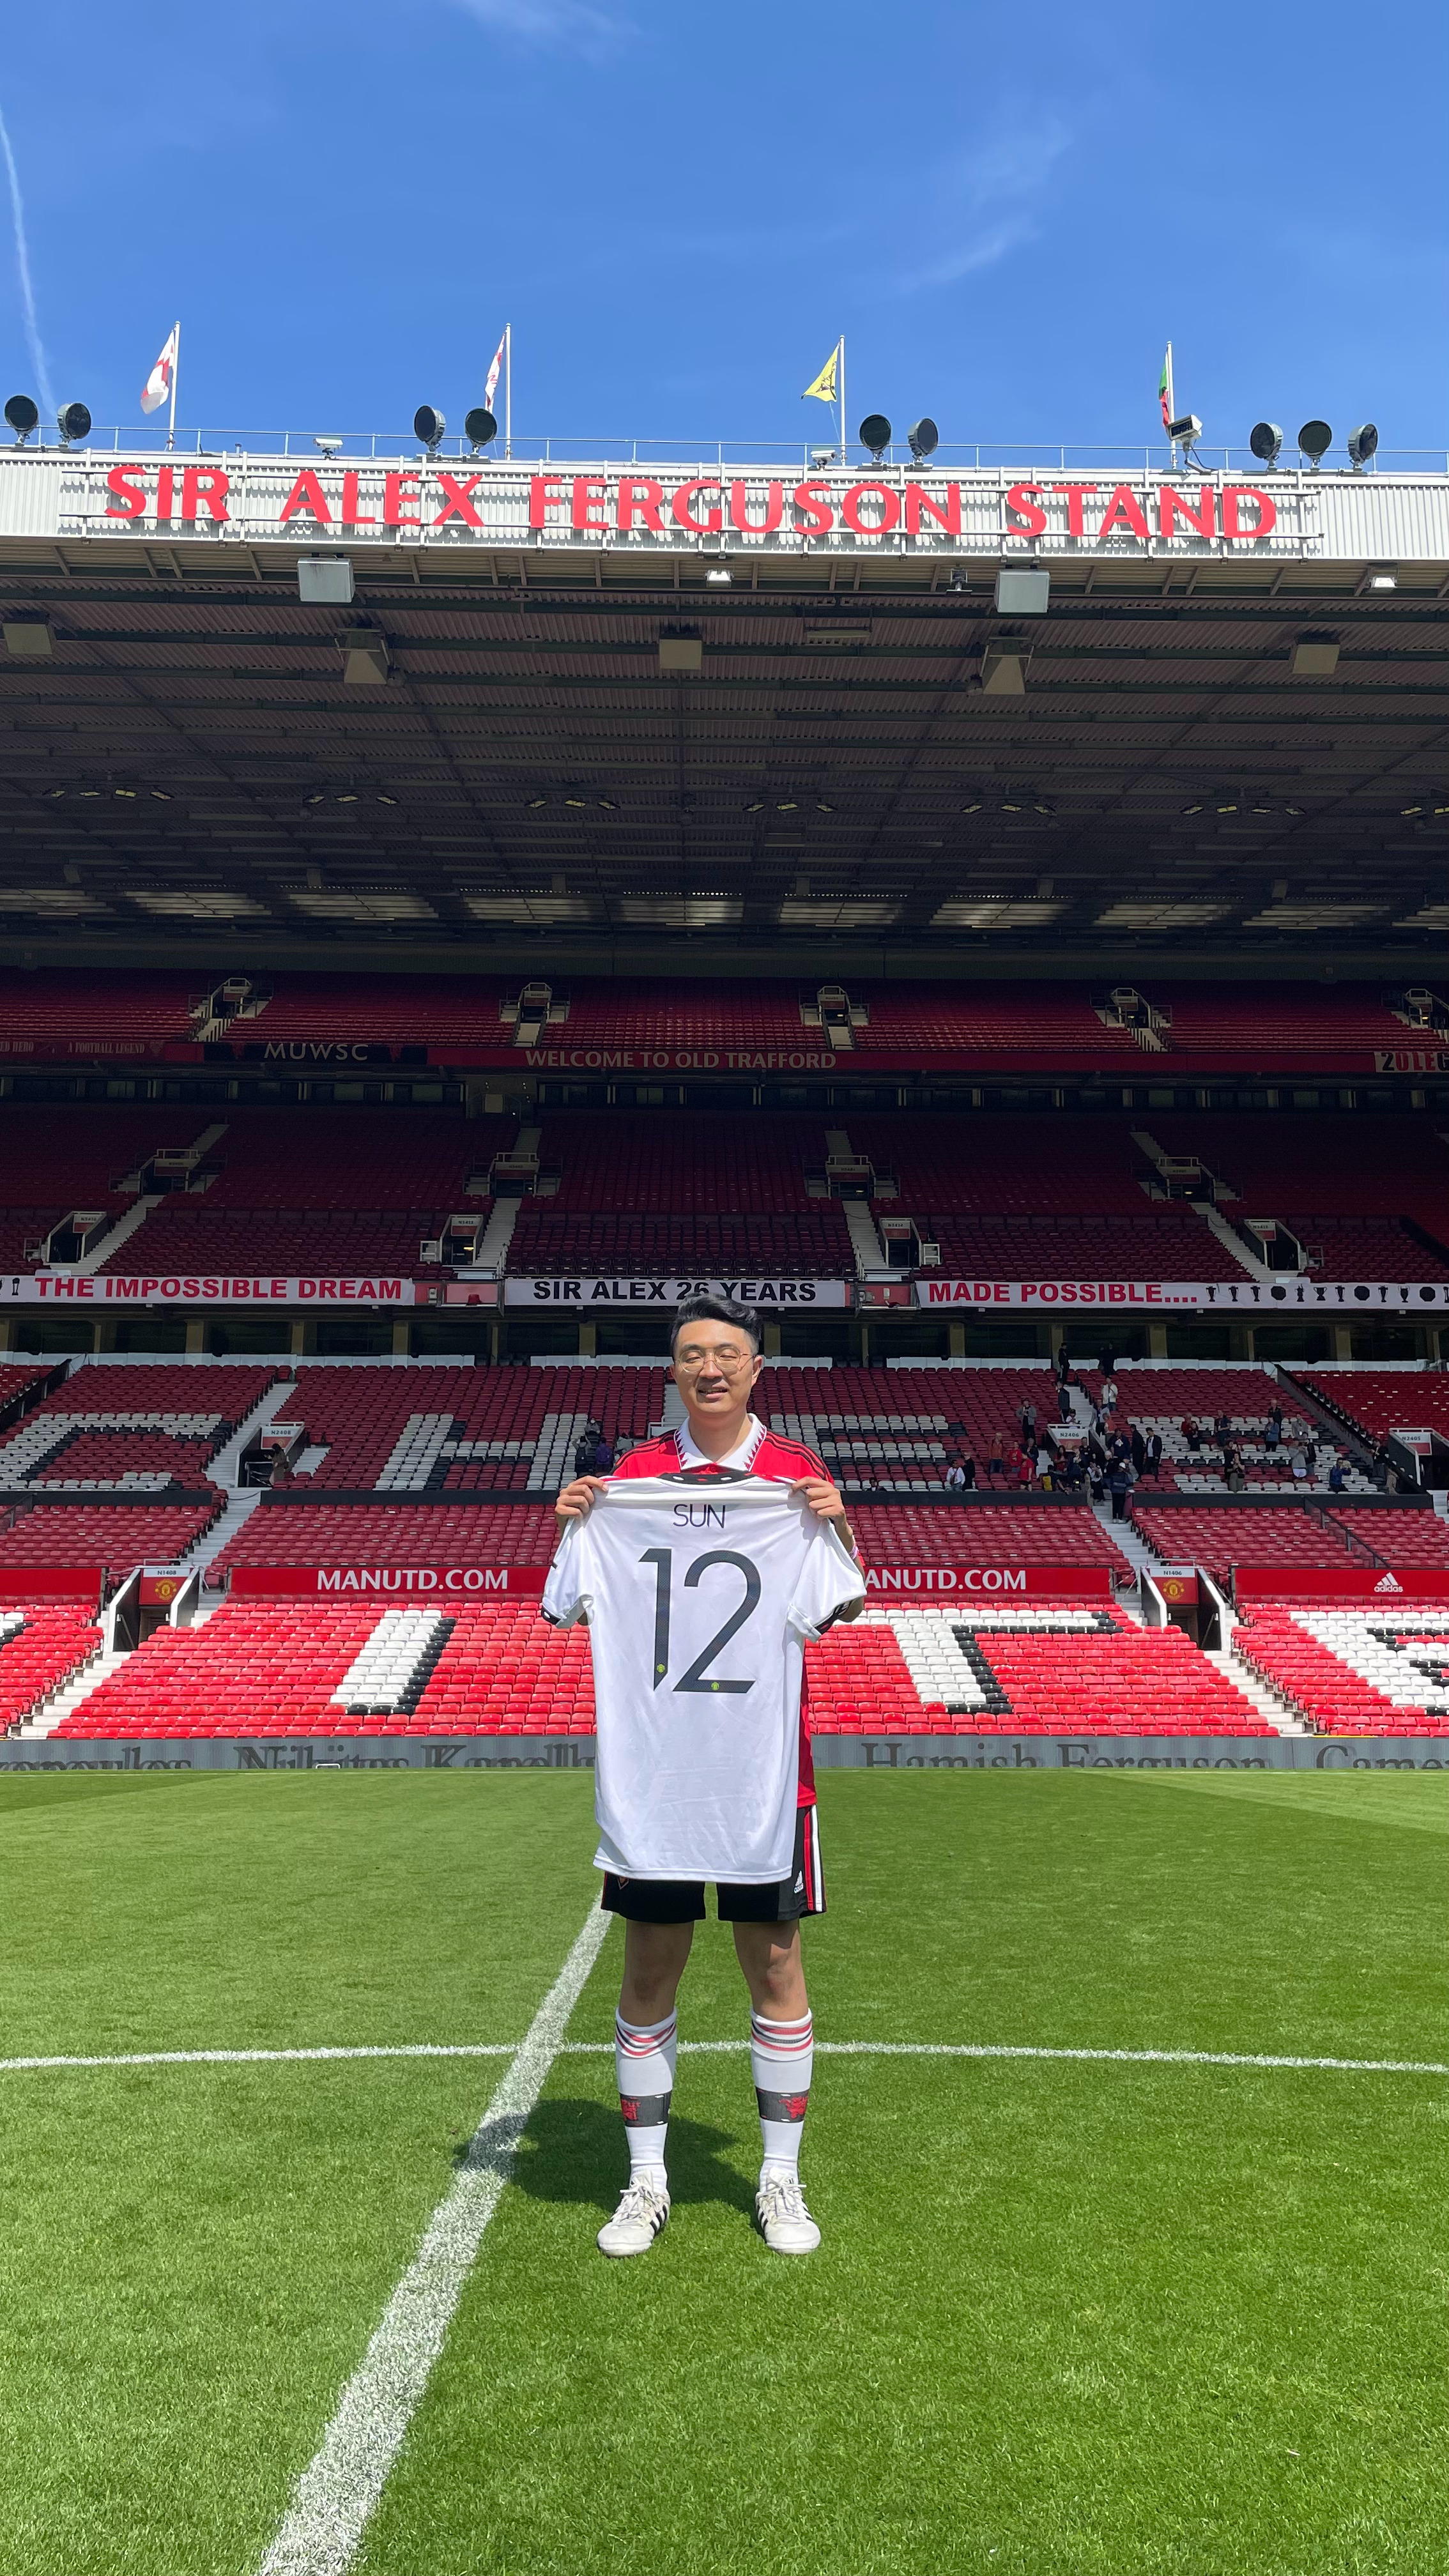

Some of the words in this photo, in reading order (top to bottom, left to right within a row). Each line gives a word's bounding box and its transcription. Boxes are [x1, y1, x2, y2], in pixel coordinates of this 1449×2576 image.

[105, 465, 230, 523] SIR
[279, 470, 486, 528] ALEX
[530, 475, 962, 535] FERGUSON
[1006, 483, 1277, 539] STAND
[75, 1042, 114, 1054] FOOTBALL
[115, 1043, 146, 1055] LEGEND
[263, 1042, 369, 1061] MUWSC
[525, 1050, 634, 1068] WELCOME
[639, 1051, 670, 1068] TO
[675, 1051, 720, 1069] OLD
[724, 1052, 837, 1070] TRAFFORD
[34, 1278, 94, 1298] THE
[105, 1278, 287, 1300] IMPOSSIBLE
[298, 1280, 401, 1300] DREAM
[533, 1280, 582, 1300] SIR
[590, 1281, 667, 1300] ALEX
[676, 1281, 709, 1300] 26
[719, 1282, 816, 1302] YEARS
[928, 1282, 1011, 1303] MADE
[673, 1503, 726, 1529] SUN
[317, 1569, 509, 1590] MANUTD.COM
[864, 1569, 1026, 1590] ANUTD.COM
[1374, 1584, 1404, 1593] adidas
[638, 1548, 762, 1694] 12
